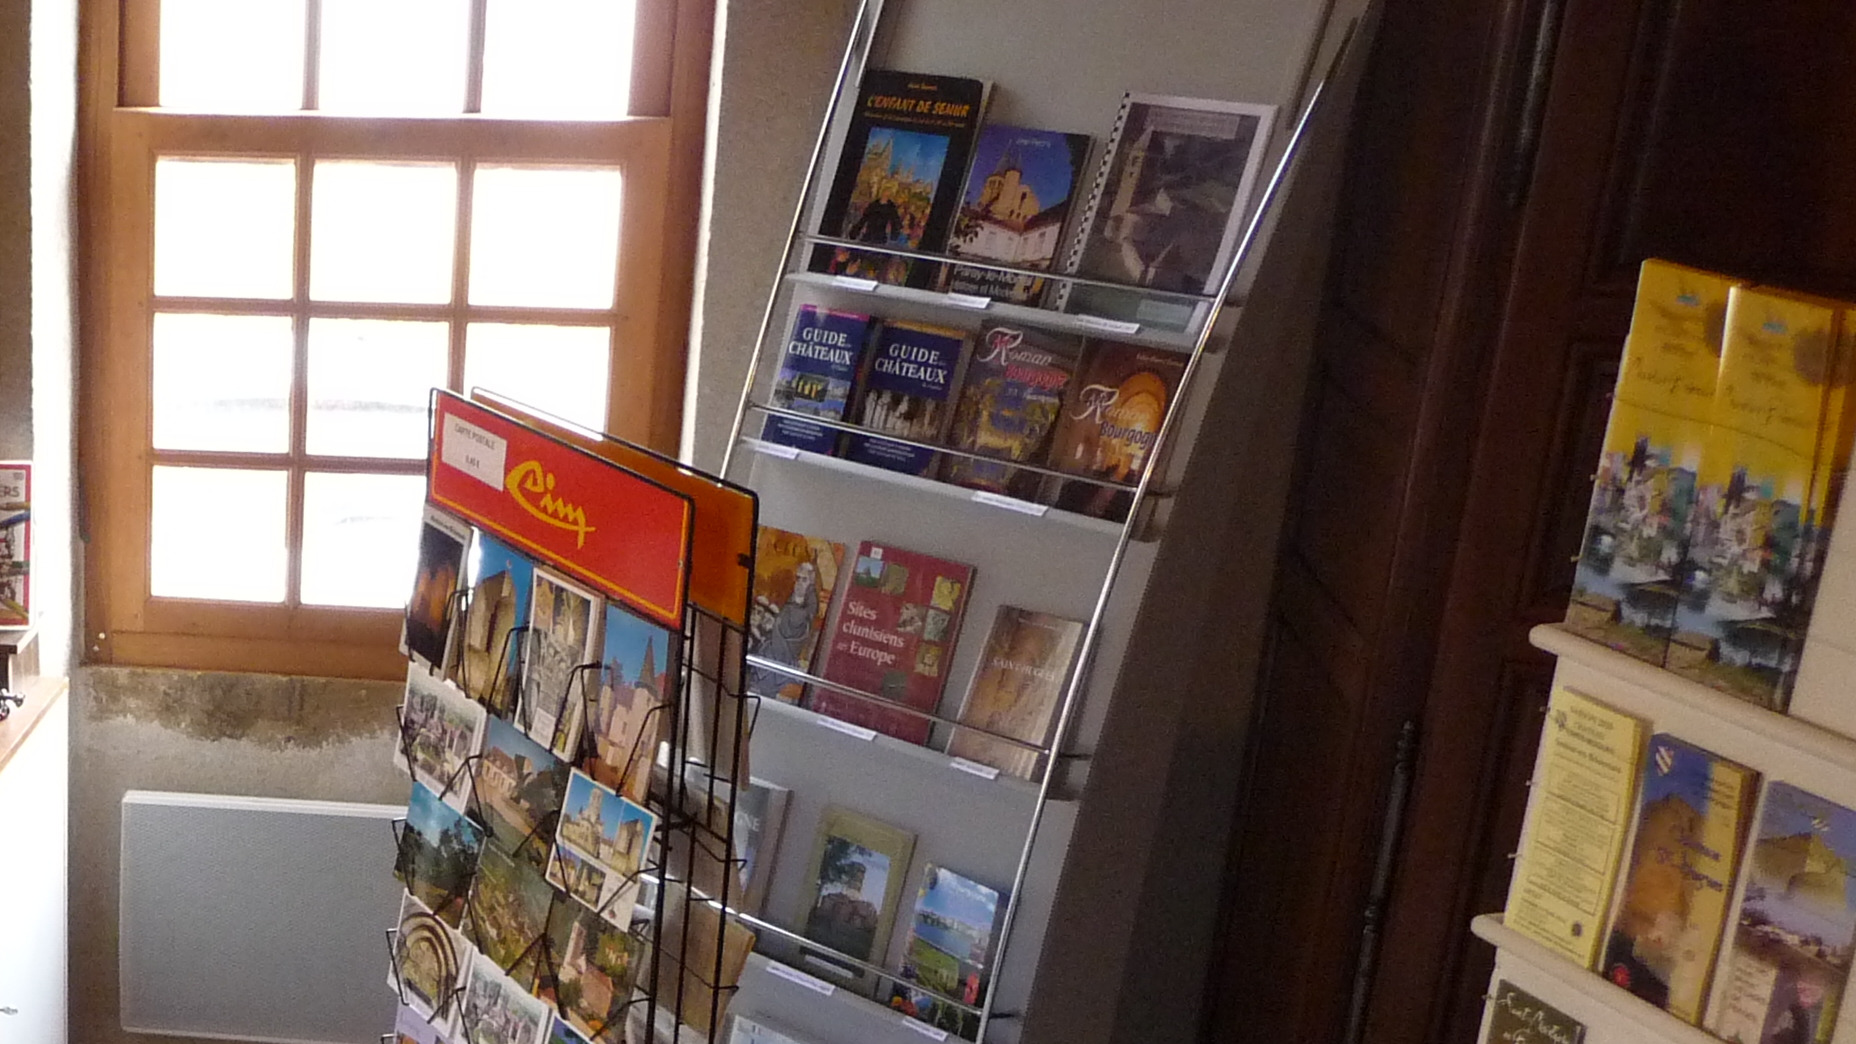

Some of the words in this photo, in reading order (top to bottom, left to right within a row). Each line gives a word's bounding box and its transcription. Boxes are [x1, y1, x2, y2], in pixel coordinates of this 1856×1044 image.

[802, 327, 848, 347] GUIDE
[788, 340, 854, 366] CHÂTEAUX
[889, 343, 941, 366] GUIDE
[875, 357, 948, 385] CHÂTEAUX
[847, 601, 878, 621] Sites
[842, 620, 905, 649] clunisiens
[849, 641, 896, 667] Europe
